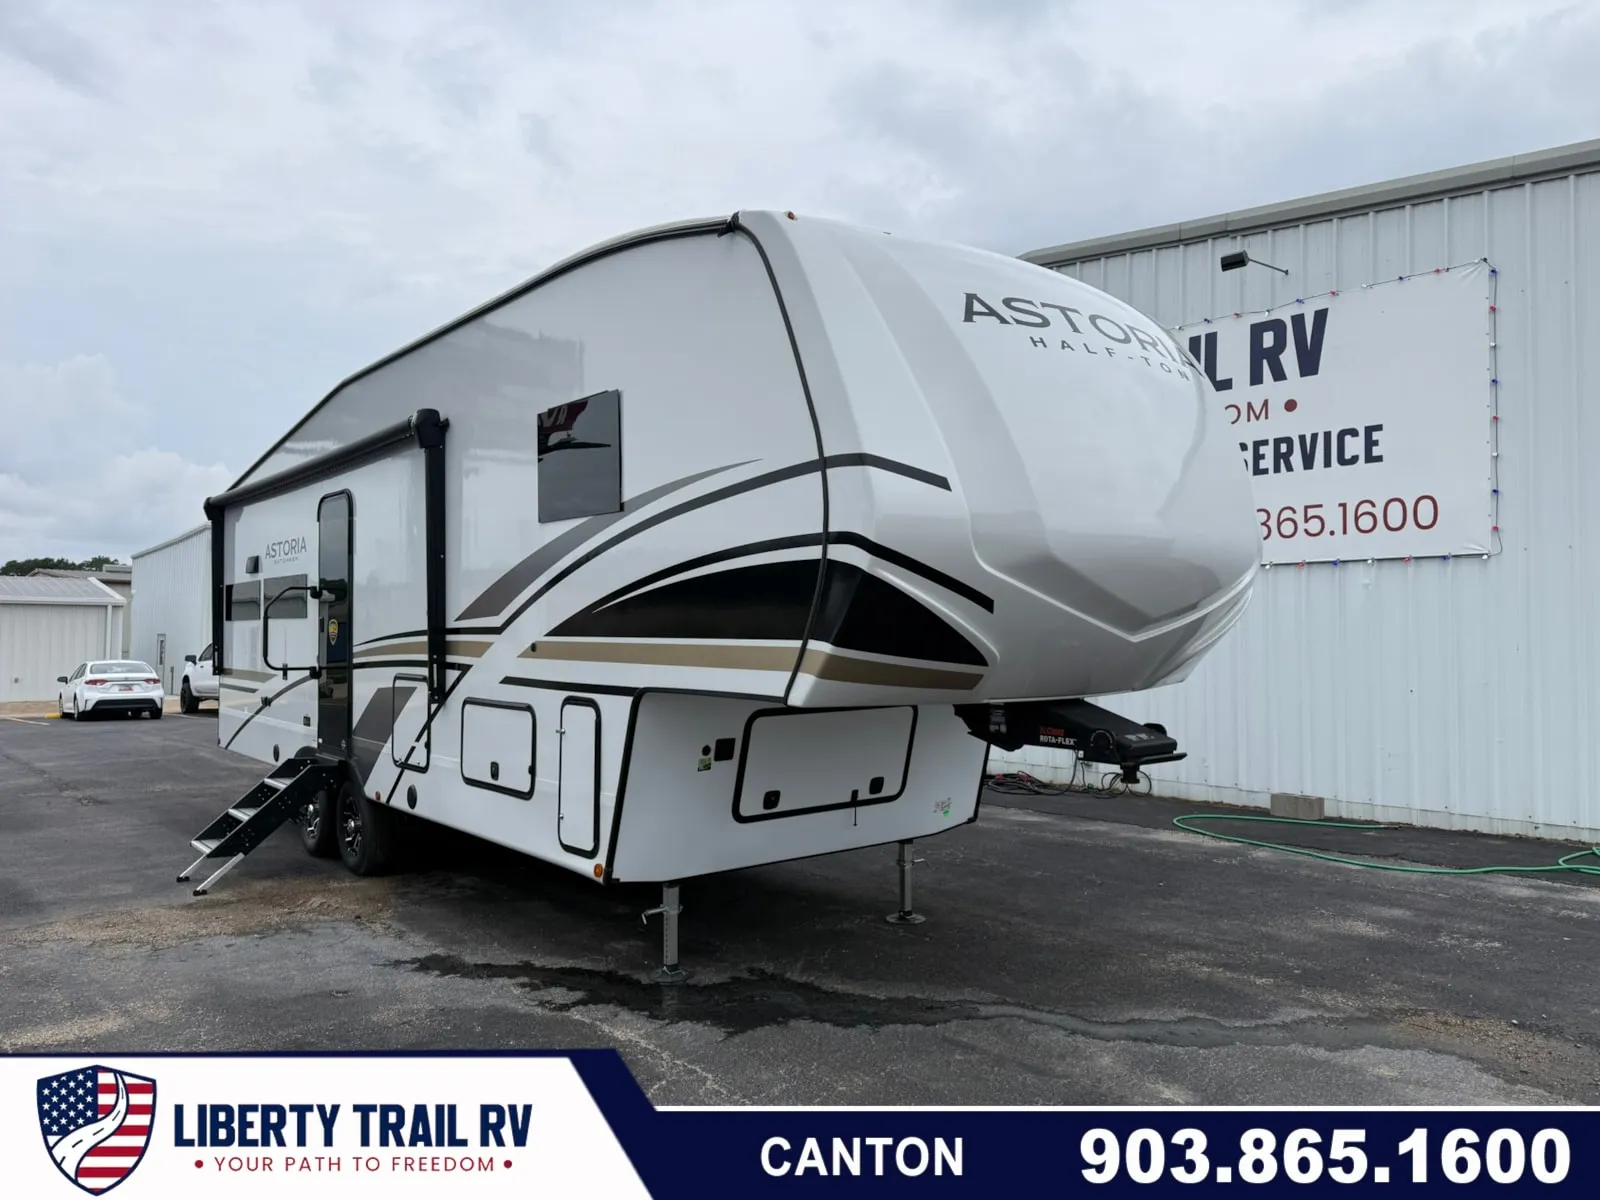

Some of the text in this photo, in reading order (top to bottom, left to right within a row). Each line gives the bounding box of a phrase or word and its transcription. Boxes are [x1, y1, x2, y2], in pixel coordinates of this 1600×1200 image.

[962, 292, 1204, 378] ASTORIA
[1029, 336, 1191, 381] HALF-TON
[1250, 307, 1329, 387] RV
[265, 536, 307, 559] ASTORIA
